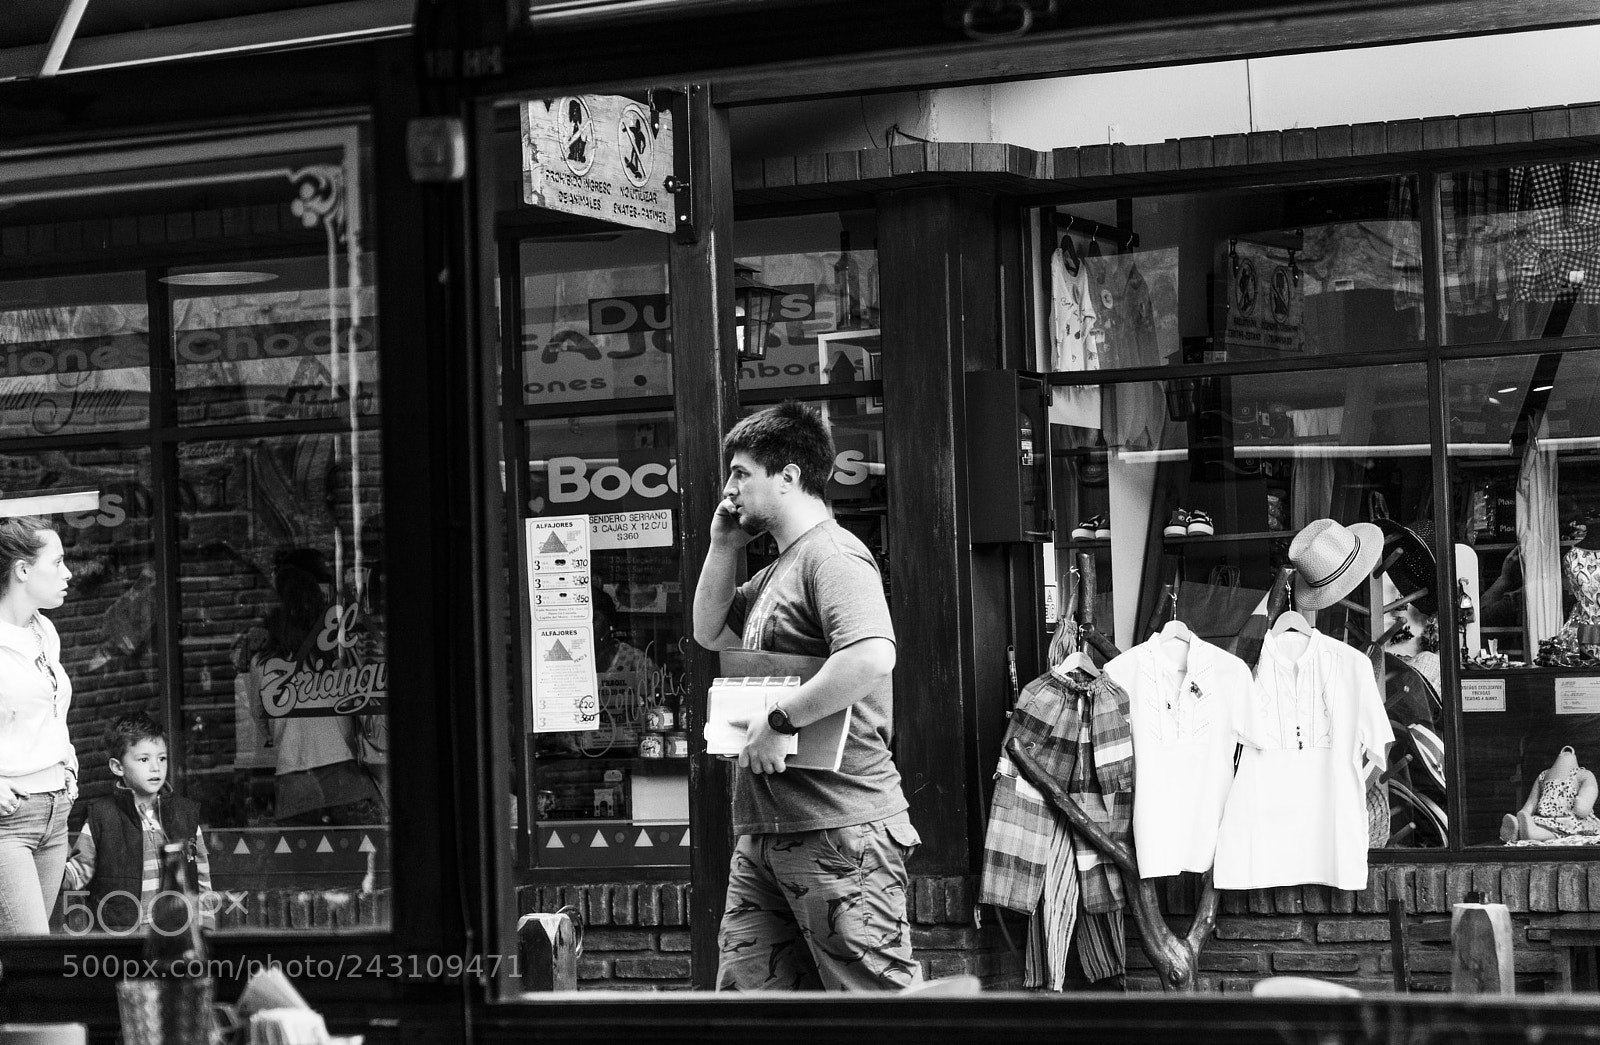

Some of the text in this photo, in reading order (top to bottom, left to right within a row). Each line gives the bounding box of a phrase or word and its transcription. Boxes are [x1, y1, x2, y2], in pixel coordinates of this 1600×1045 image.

[545, 169, 612, 195] PROHIBIDO INGRESO
[558, 191, 602, 211] DE ANIMALES
[620, 186, 658, 205] NO UTILIZAR
[0, 342, 150, 377] iones
[548, 456, 678, 503] Boc
[589, 511, 667, 524] SENDERO SERRANO
[536, 521, 573, 529] ALFAJORES
[601, 523, 629, 533] CAJAS
[631, 523, 637, 531] X
[641, 522, 649, 530] 12
[651, 521, 667, 530] C/U
[534, 560, 541, 571] 3
[535, 578, 541, 589] 3
[536, 594, 542, 605] 3
[317, 602, 359, 652] El
[541, 629, 578, 637] ALFAJORES
